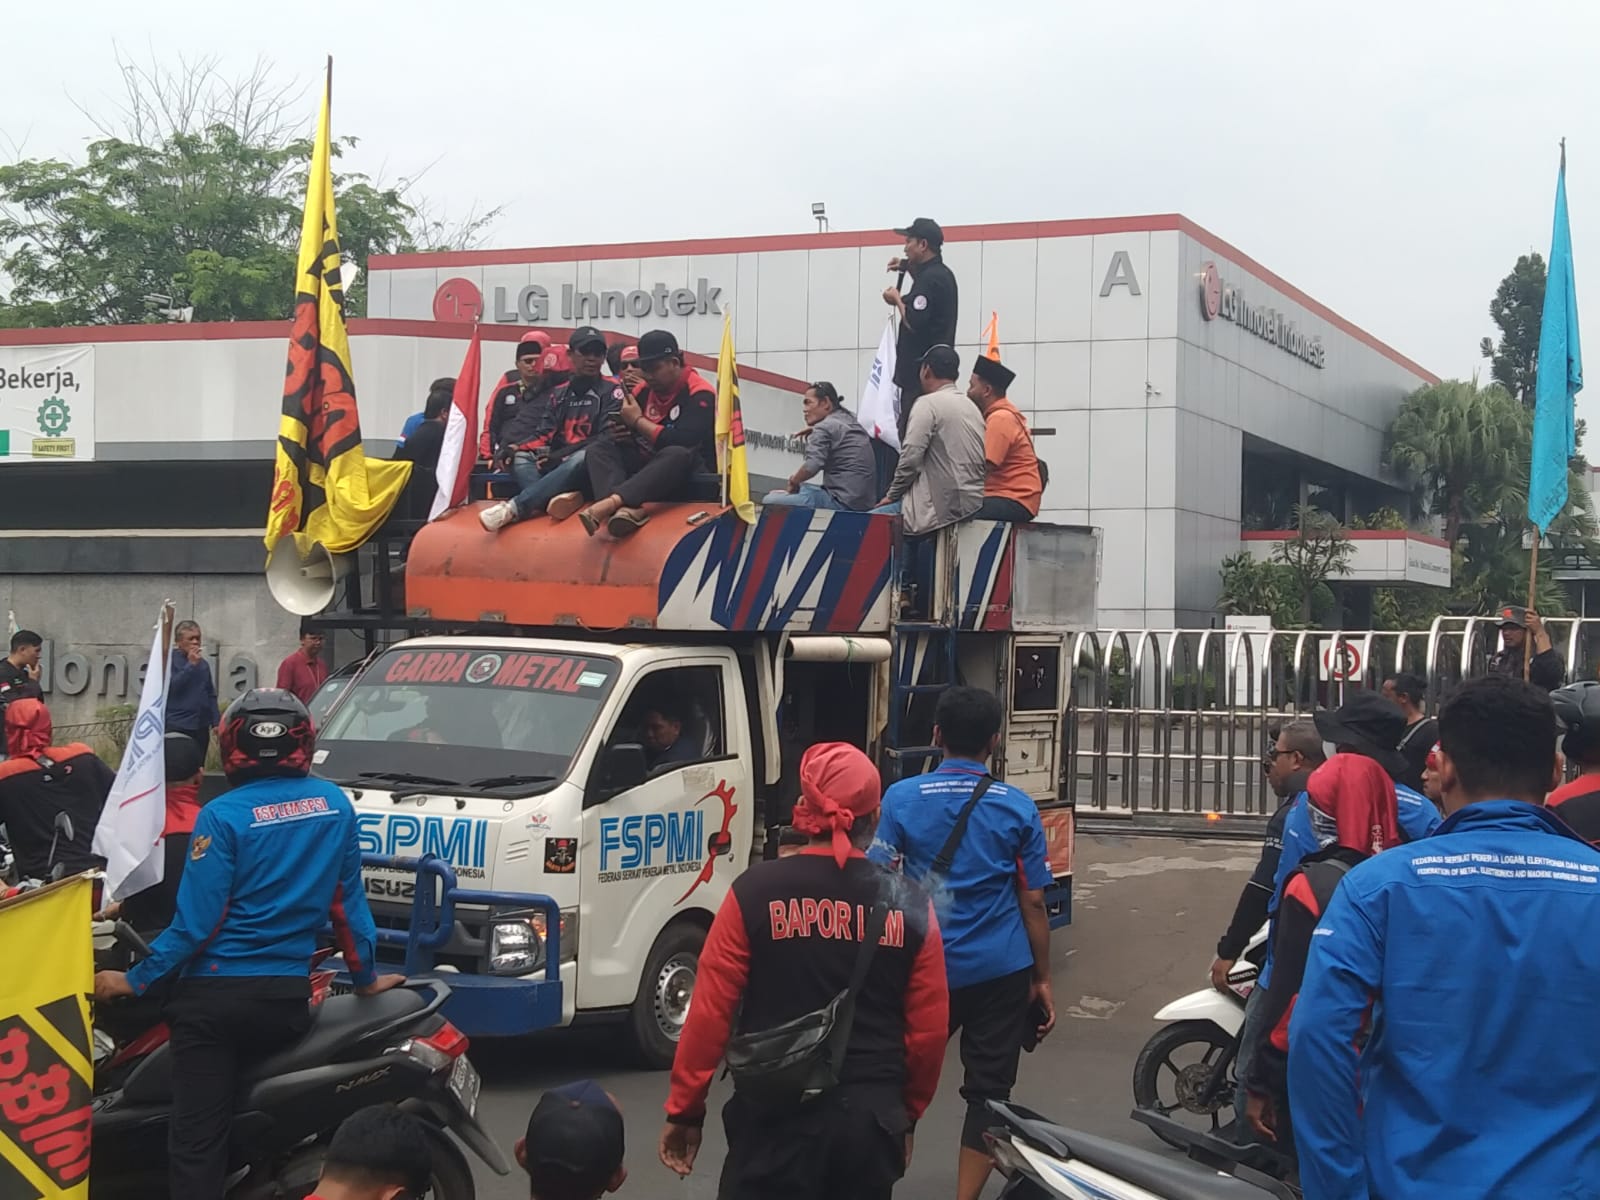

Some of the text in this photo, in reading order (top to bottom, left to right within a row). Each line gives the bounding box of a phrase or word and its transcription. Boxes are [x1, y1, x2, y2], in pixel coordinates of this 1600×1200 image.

[1099, 250, 1141, 297] A
[494, 278, 722, 322] LG Innotek
[1218, 278, 1236, 321] LG
[385, 652, 471, 683] GARDA
[492, 655, 588, 693] METAL
[357, 813, 488, 868] SPMI
[600, 810, 704, 872] FSPMI
[1412, 856, 1443, 866] FEDERASI
[364, 876, 416, 898] ISUZ
[452, 866, 486, 879] DONESIA
[598, 871, 621, 884] FEDERASI
[622, 868, 641, 880] SERIKAT
[642, 866, 663, 878] PEKERJA
[663, 864, 677, 875] METAL
[769, 897, 905, 948] BAPOR LM
